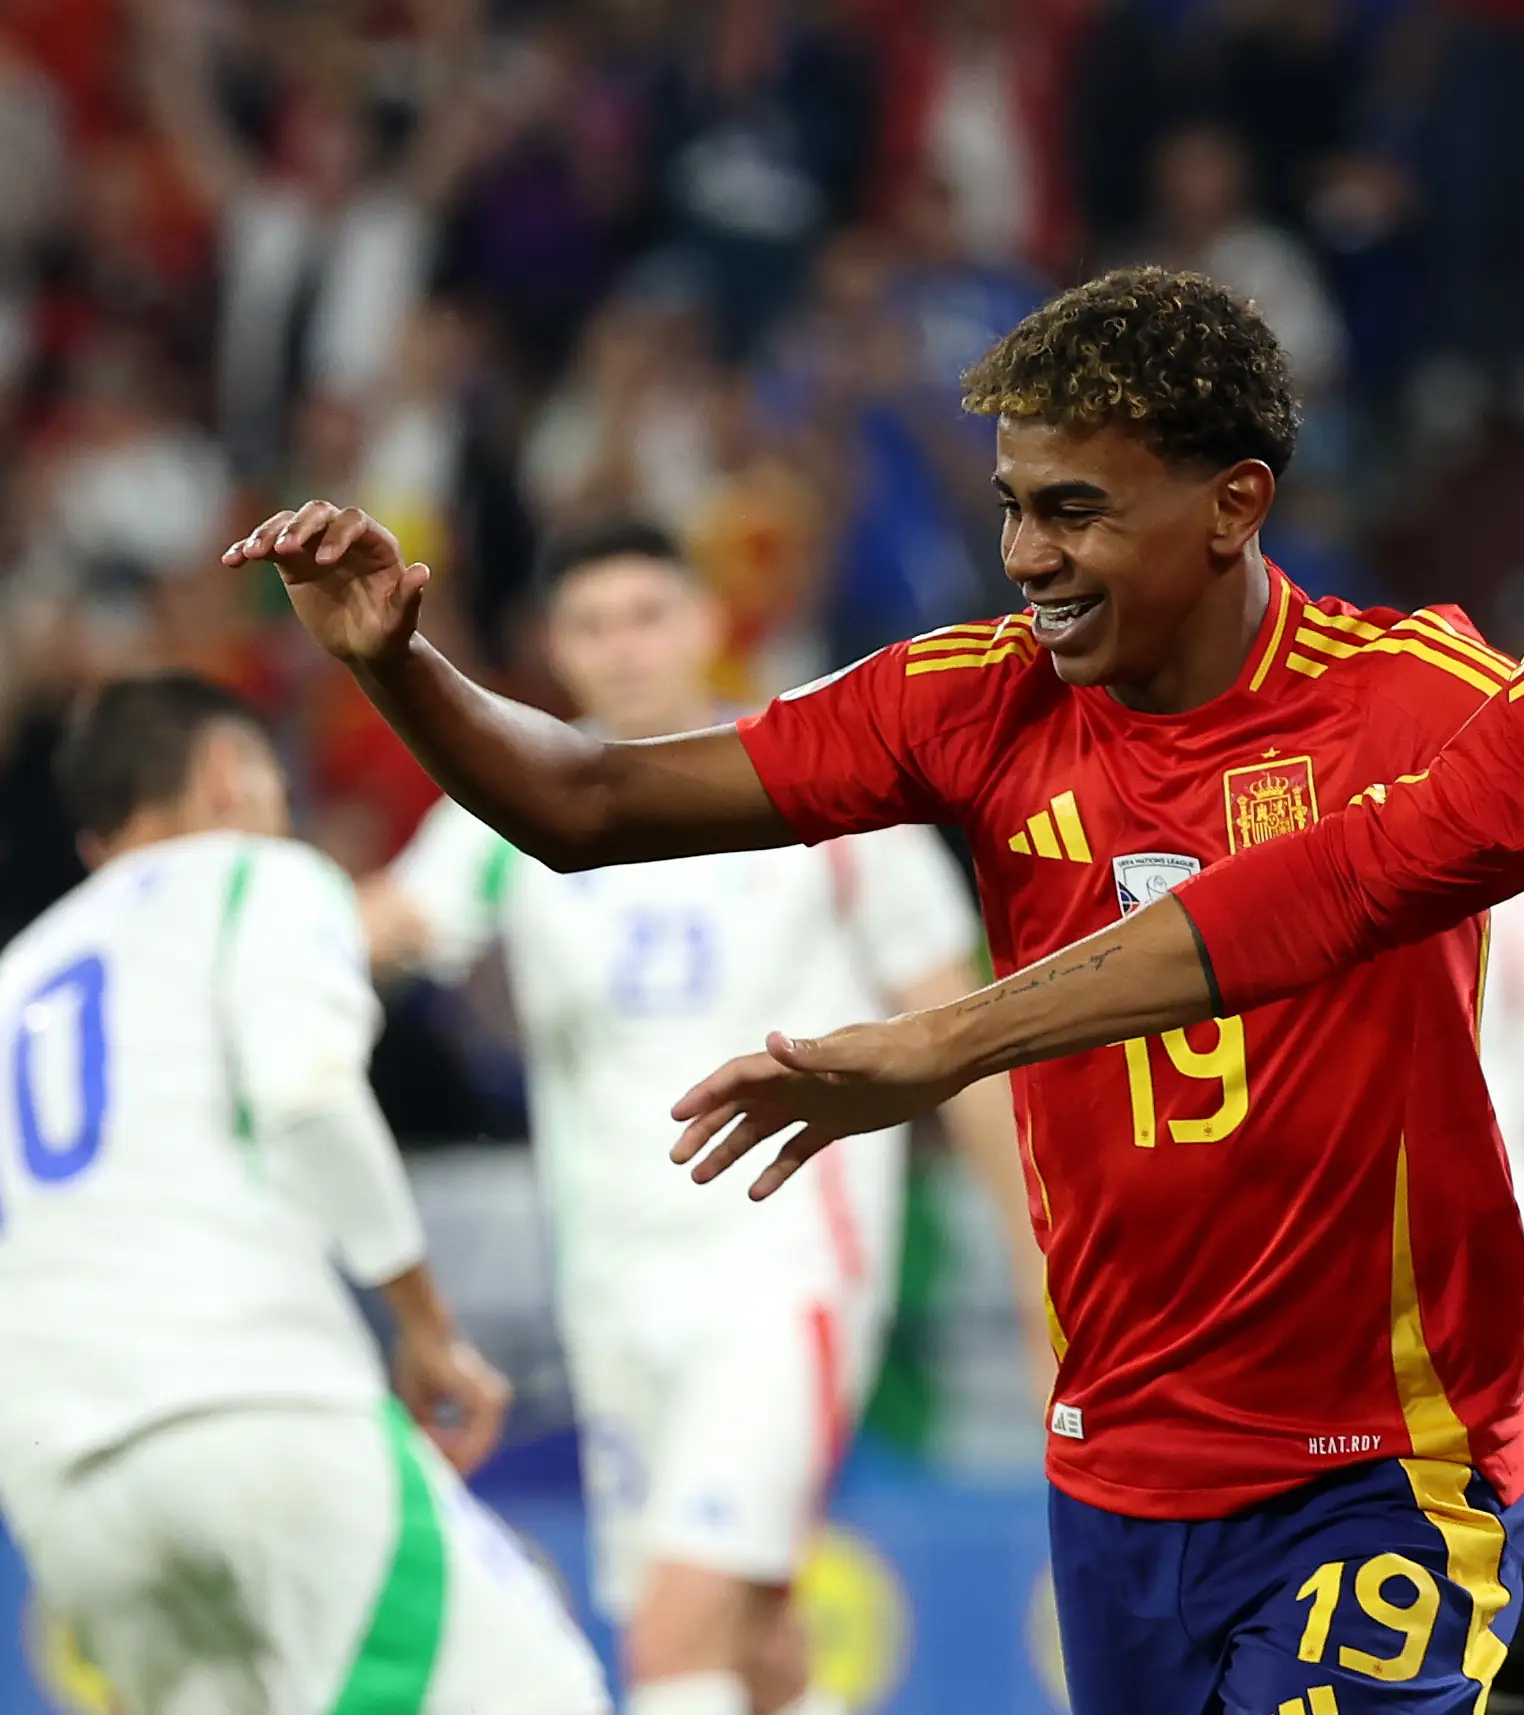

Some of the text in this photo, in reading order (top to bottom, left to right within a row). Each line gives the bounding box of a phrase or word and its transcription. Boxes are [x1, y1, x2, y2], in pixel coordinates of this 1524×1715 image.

[1106, 1015, 1248, 1148] 19
[1308, 1434, 1381, 1455] HEAT.RDY
[1295, 1552, 1441, 1682] 19
